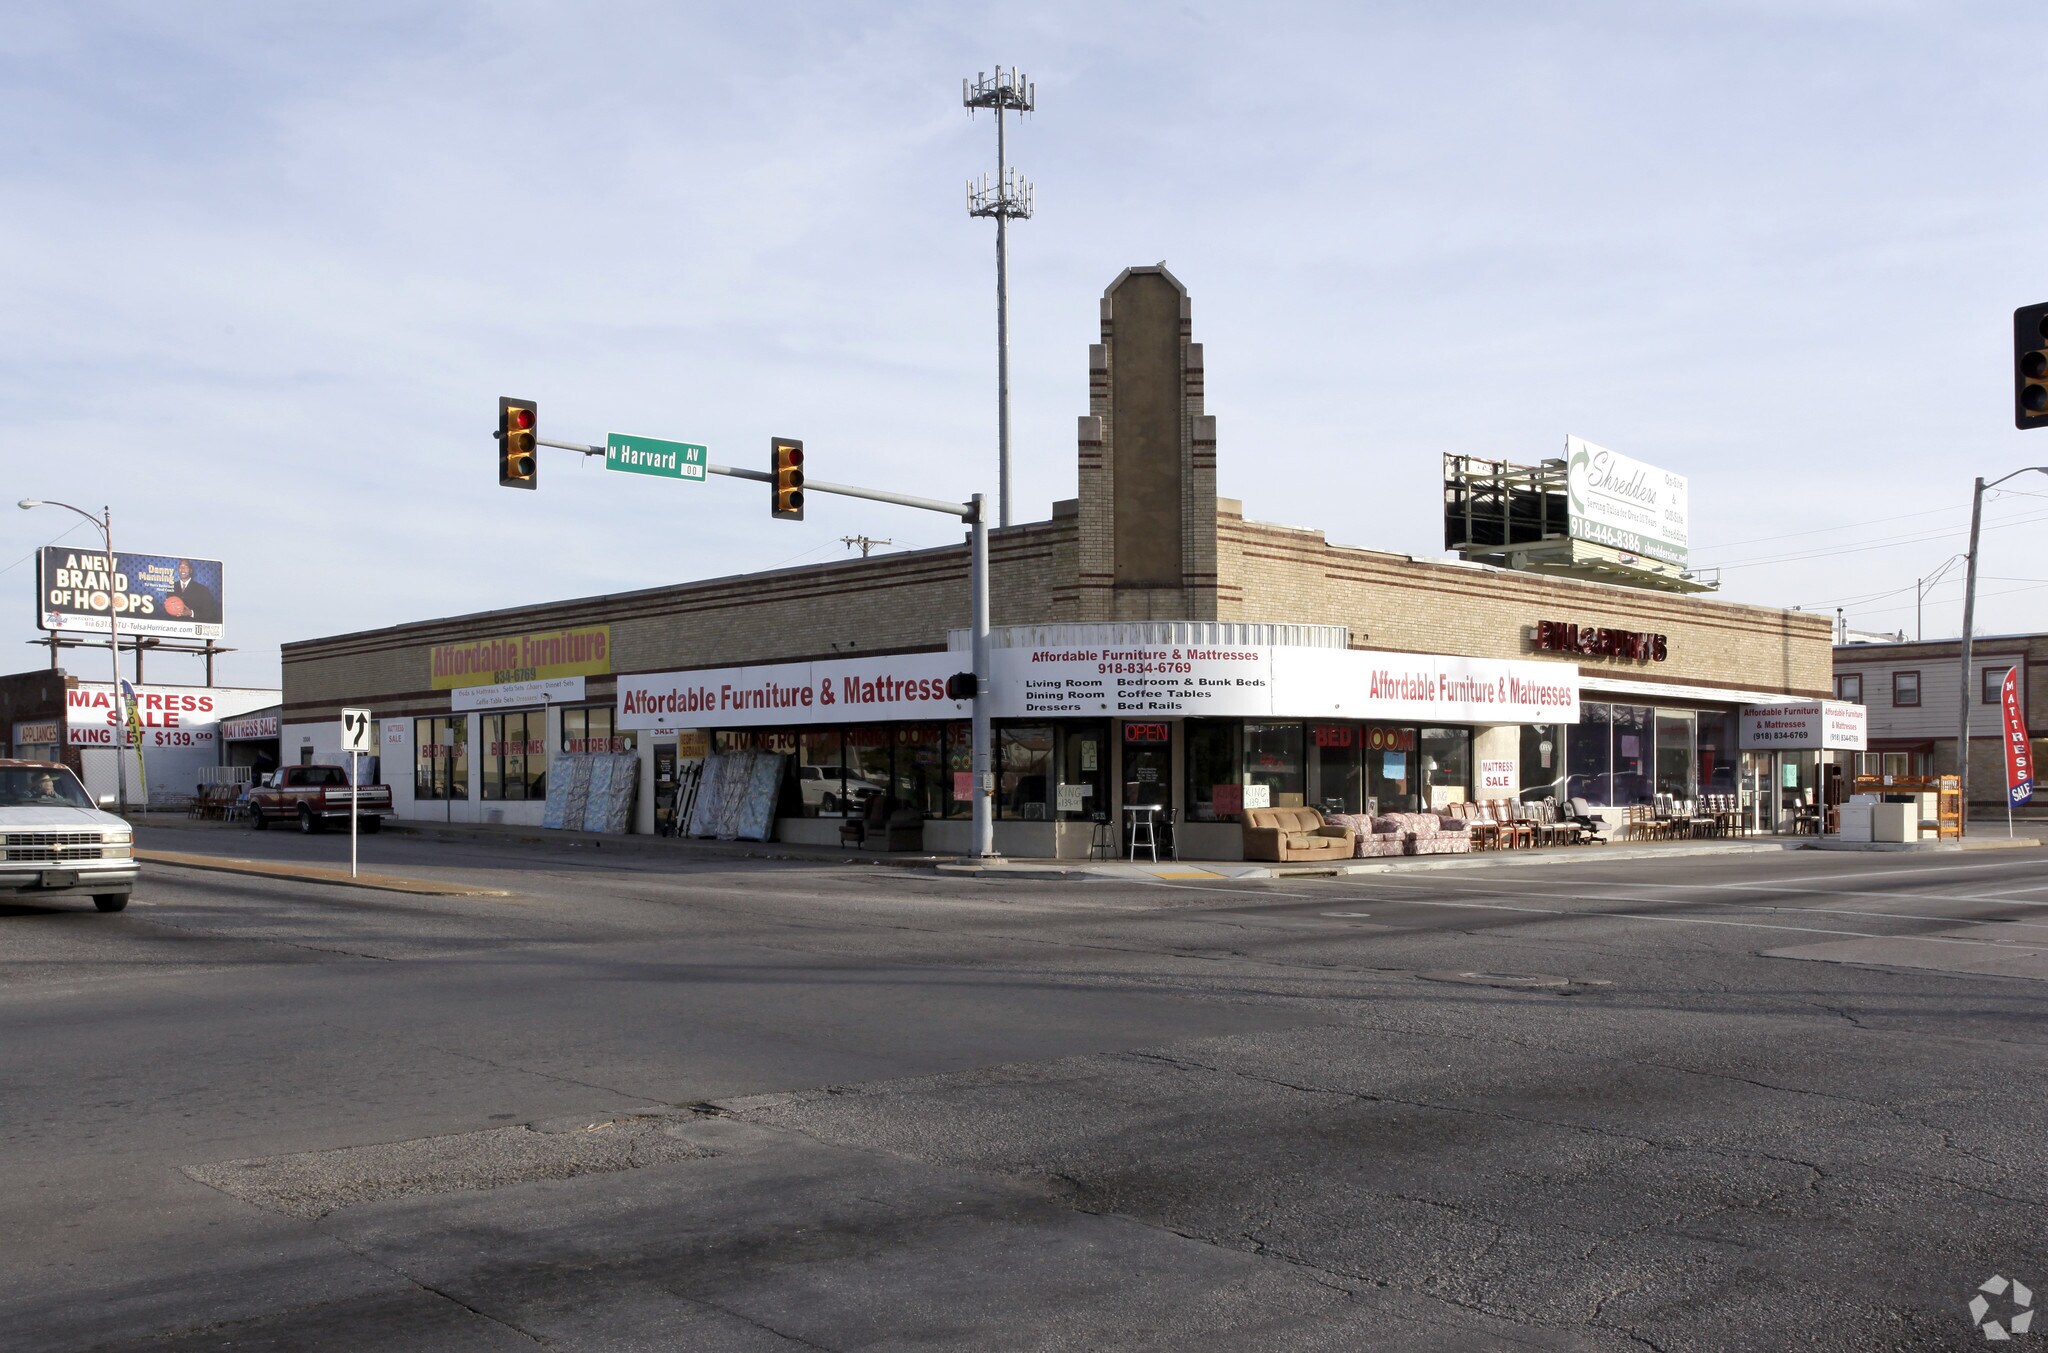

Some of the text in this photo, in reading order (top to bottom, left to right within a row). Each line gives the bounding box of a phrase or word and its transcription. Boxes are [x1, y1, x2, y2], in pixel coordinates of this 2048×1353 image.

[609, 445, 677, 470] N Harvard
[686, 448, 699, 461] AV
[687, 465, 697, 475] 00
[1588, 451, 1657, 504] Shredders
[1672, 493, 1677, 504] &
[1587, 497, 1605, 514] Serving
[1606, 503, 1619, 516] Tulsa
[1628, 510, 1639, 522] Over
[1645, 515, 1657, 527] Years
[1571, 517, 1640, 553] 918-446-8386
[1662, 525, 1687, 546] Shredding
[1644, 542, 1688, 565] shreddersinc.net
[66, 554, 118, 572] A NEW
[148, 564, 174, 577] Danny
[57, 569, 128, 592] BRAND
[138, 571, 175, 585] Manning
[51, 590, 155, 614] OF HOOPS
[130, 622, 193, 633] TulsaHurricane.com
[434, 631, 606, 677] Affordable Furniture
[1032, 649, 1259, 663] Affordable Furniture & Mattresses
[1098, 662, 1192, 674] 918-834-6769
[494, 667, 537, 684] 834-6769
[526, 682, 543, 691] Chairs
[1026, 679, 1102, 689] Living Room
[1117, 678, 1266, 687] Bedroom & Bunk Beds
[1370, 670, 1572, 706] Affordable Furniture & Mattresses
[490, 696, 502, 704] Table
[623, 675, 952, 714] Affordable Furniture & Mattress
[1026, 691, 1105, 700] Dining Room
[1117, 689, 1212, 698] Coffee Tables
[1026, 703, 1081, 711] Dressers
[1117, 702, 1183, 710] Bed Rails
[1744, 707, 1819, 717] Affordable Furniture
[1825, 707, 1863, 719] Affordable Furniture
[223, 717, 277, 738] MATTRESS SALE
[1756, 720, 1806, 729] & Mattresses
[1835, 721, 1857, 731] Mattresses
[2006, 680, 2028, 780] MATTRESS
[22, 725, 57, 742] APPLIANCES
[71, 728, 111, 743] KING
[389, 734, 402, 743] SALE
[1126, 724, 1168, 741] OPEN
[1315, 727, 1352, 747] BED
[1753, 731, 1808, 741] (918) 834-6769
[1483, 761, 1514, 772] MATTRESS
[1485, 776, 1509, 787] SALE
[1058, 787, 1081, 798] KING
[1245, 787, 1266, 797] KING
[2012, 782, 2031, 802] SALE
